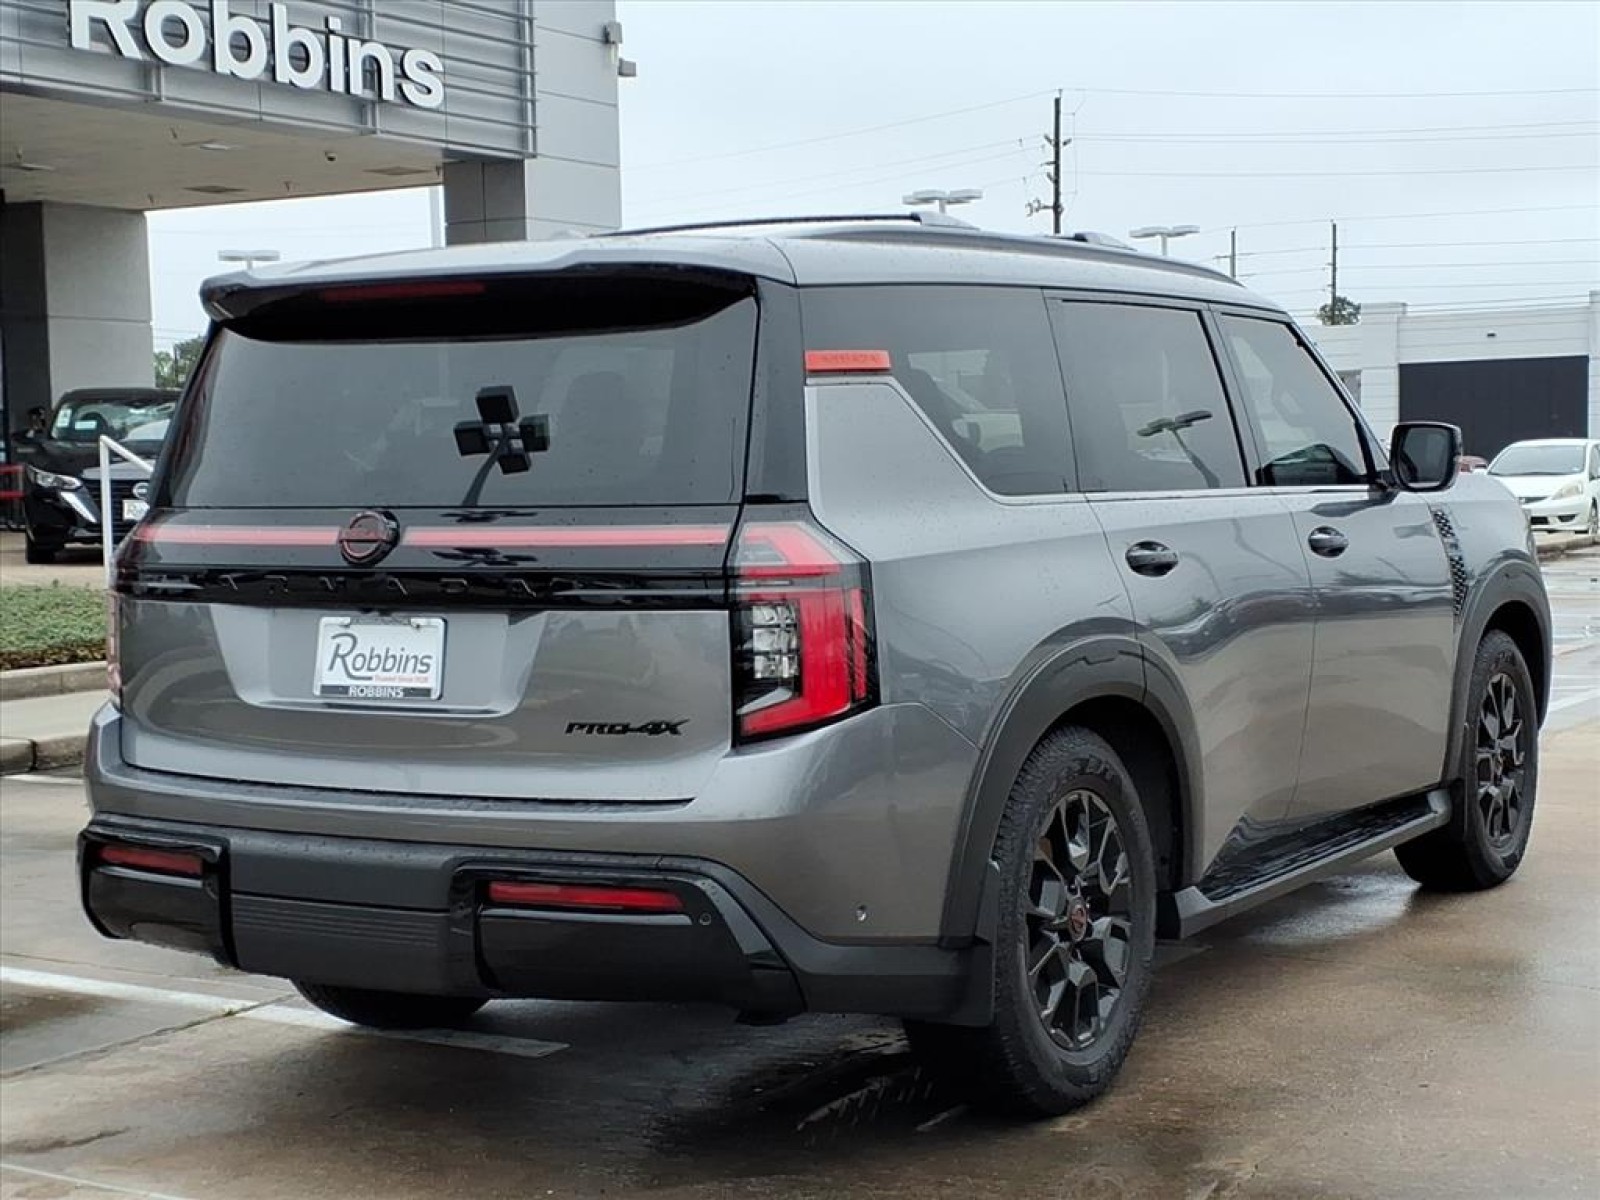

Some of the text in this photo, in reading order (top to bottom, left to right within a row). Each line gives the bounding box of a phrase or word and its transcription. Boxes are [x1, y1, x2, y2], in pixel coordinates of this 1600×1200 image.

[328, 633, 433, 680] Robbins
[349, 686, 404, 698] ROBBINS
[565, 719, 690, 736] PRO-4X
